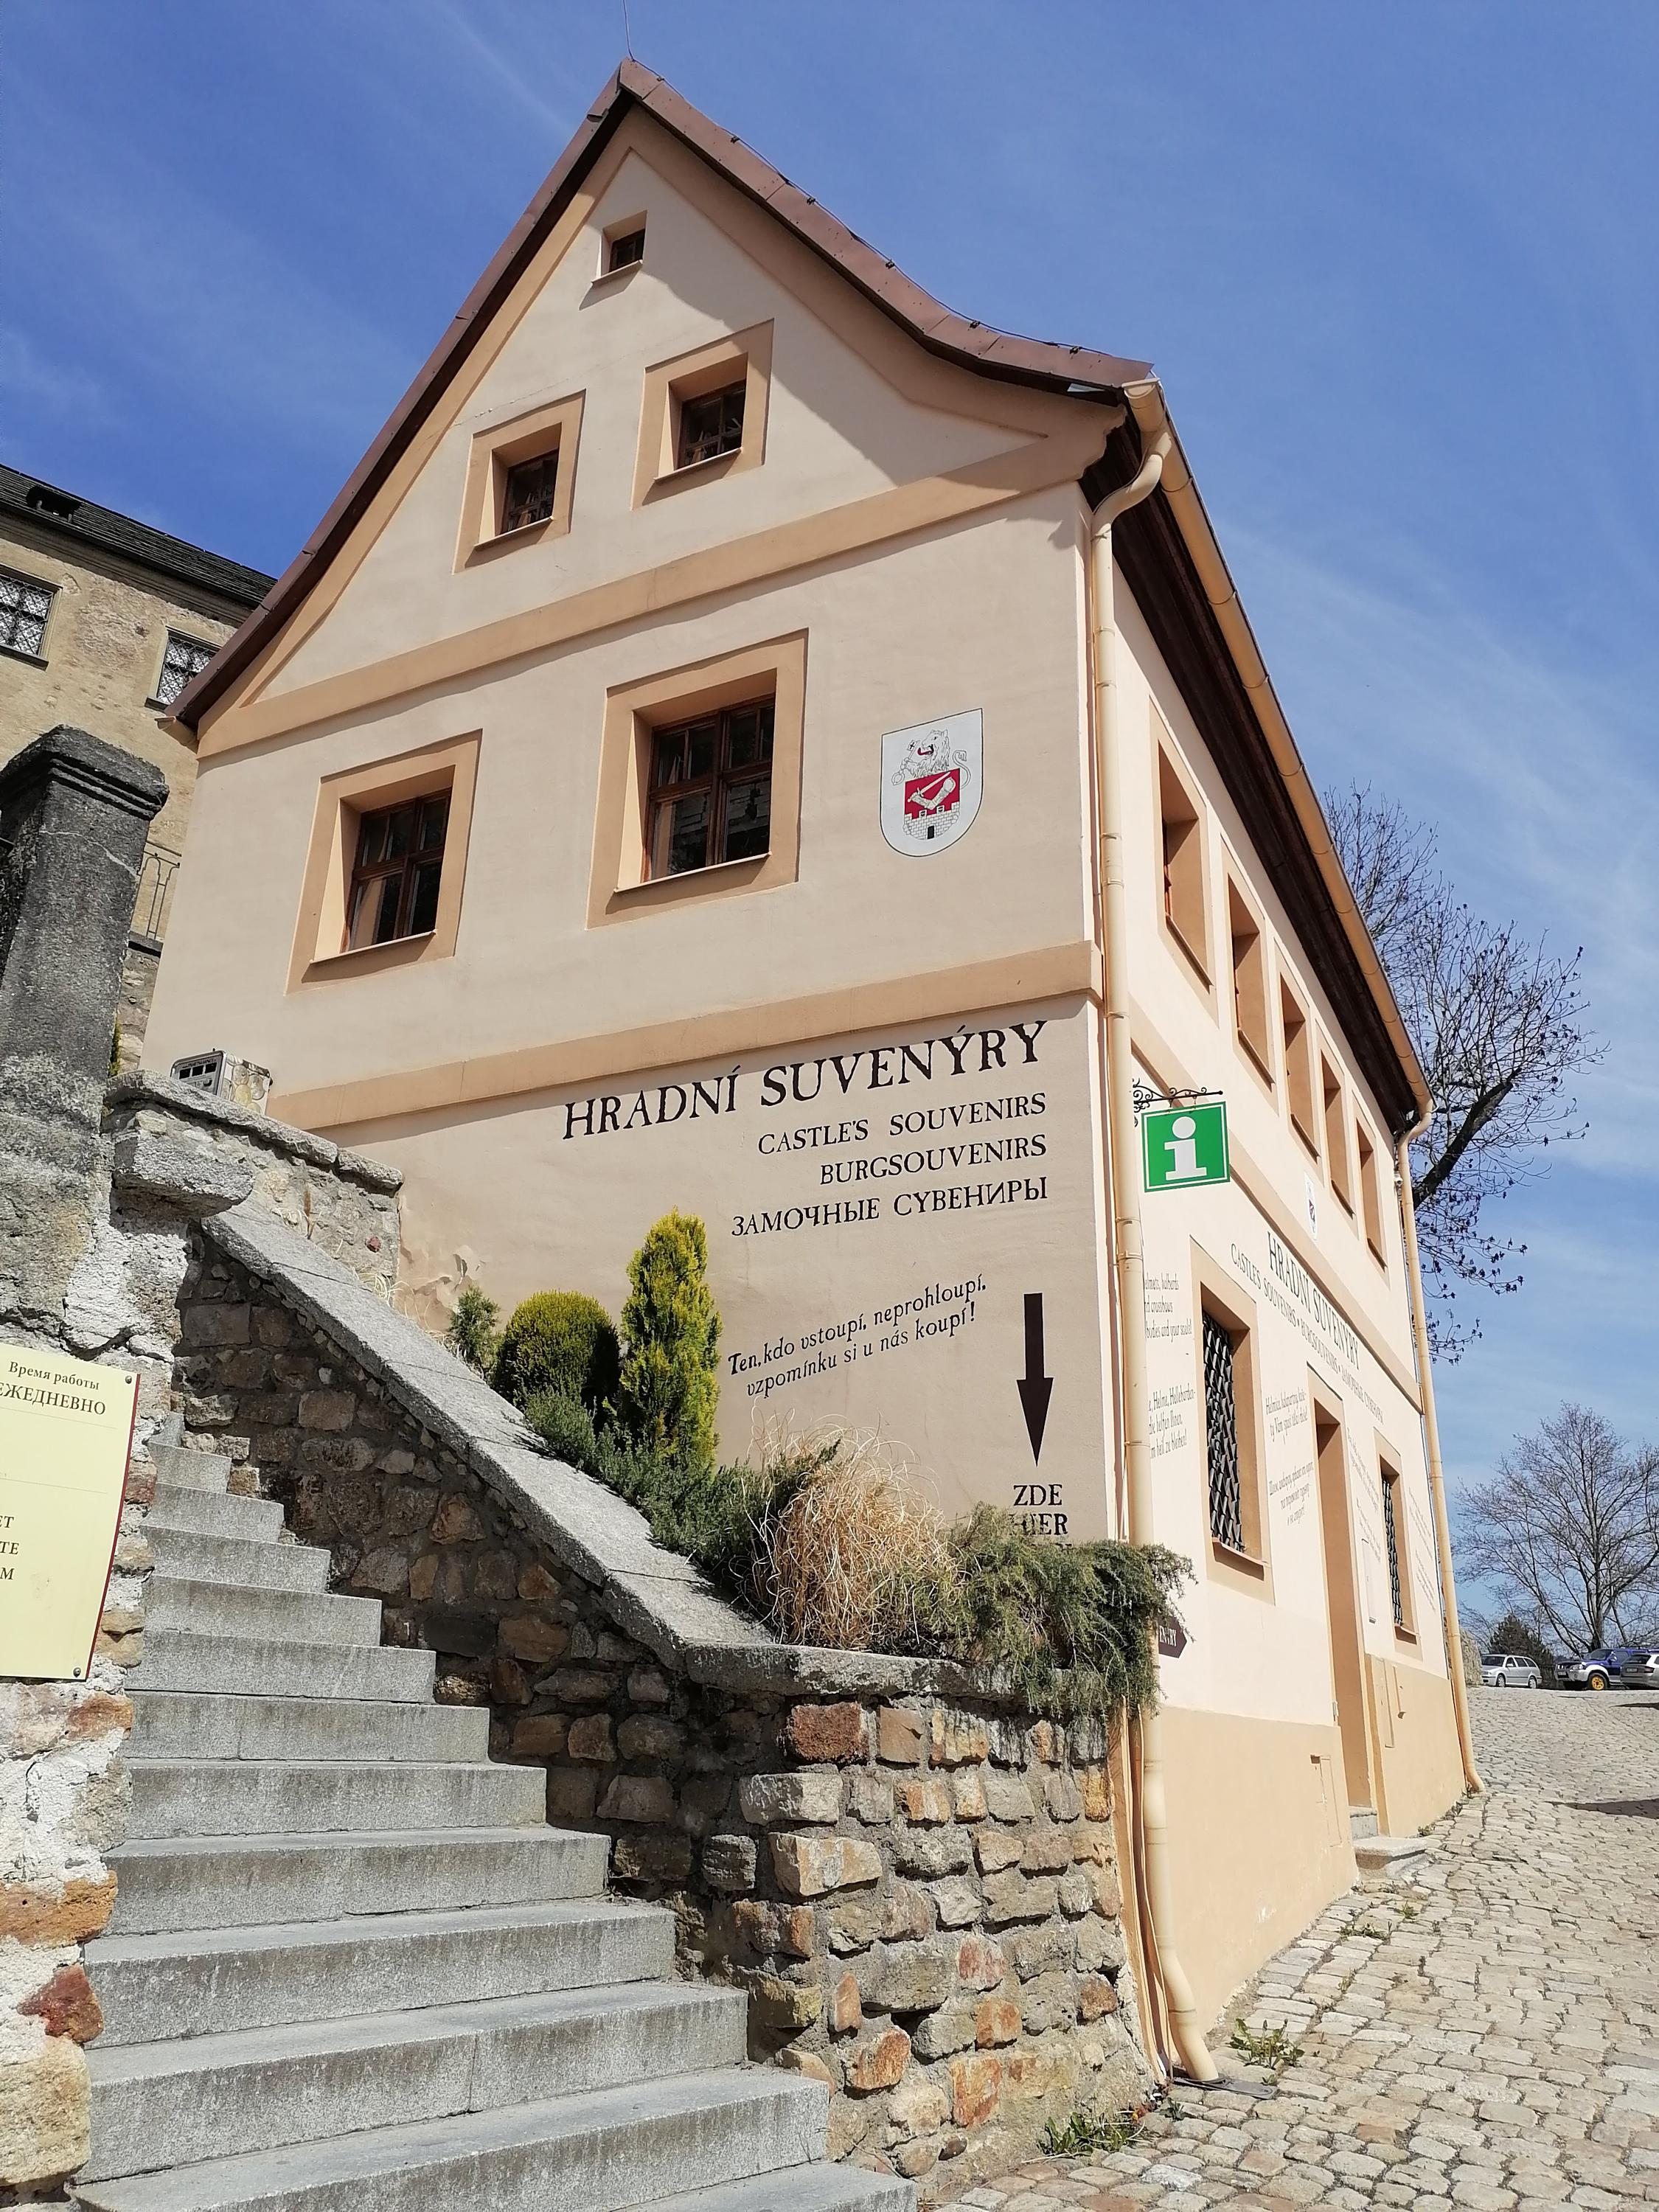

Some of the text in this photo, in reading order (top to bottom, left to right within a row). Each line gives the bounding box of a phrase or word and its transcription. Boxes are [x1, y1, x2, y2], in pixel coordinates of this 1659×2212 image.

[563, 1020, 1048, 1140] HRADNÍ SUVENÝRY
[758, 1092, 1046, 1155] CASTLE'S SOUVENIRS
[819, 1134, 1047, 1186] BURGSOUVENIRS
[731, 1176, 1048, 1237] ЗАМОЧНЫЕ СУВЕНИРЫ
[8, 1361, 100, 1391] Время работы
[747, 1350, 838, 1399] vzpomínku
[844, 1343, 857, 1363] si
[863, 1341, 873, 1357] u
[880, 1329, 909, 1352] nás
[1013, 1484, 1062, 1506] ZDE
